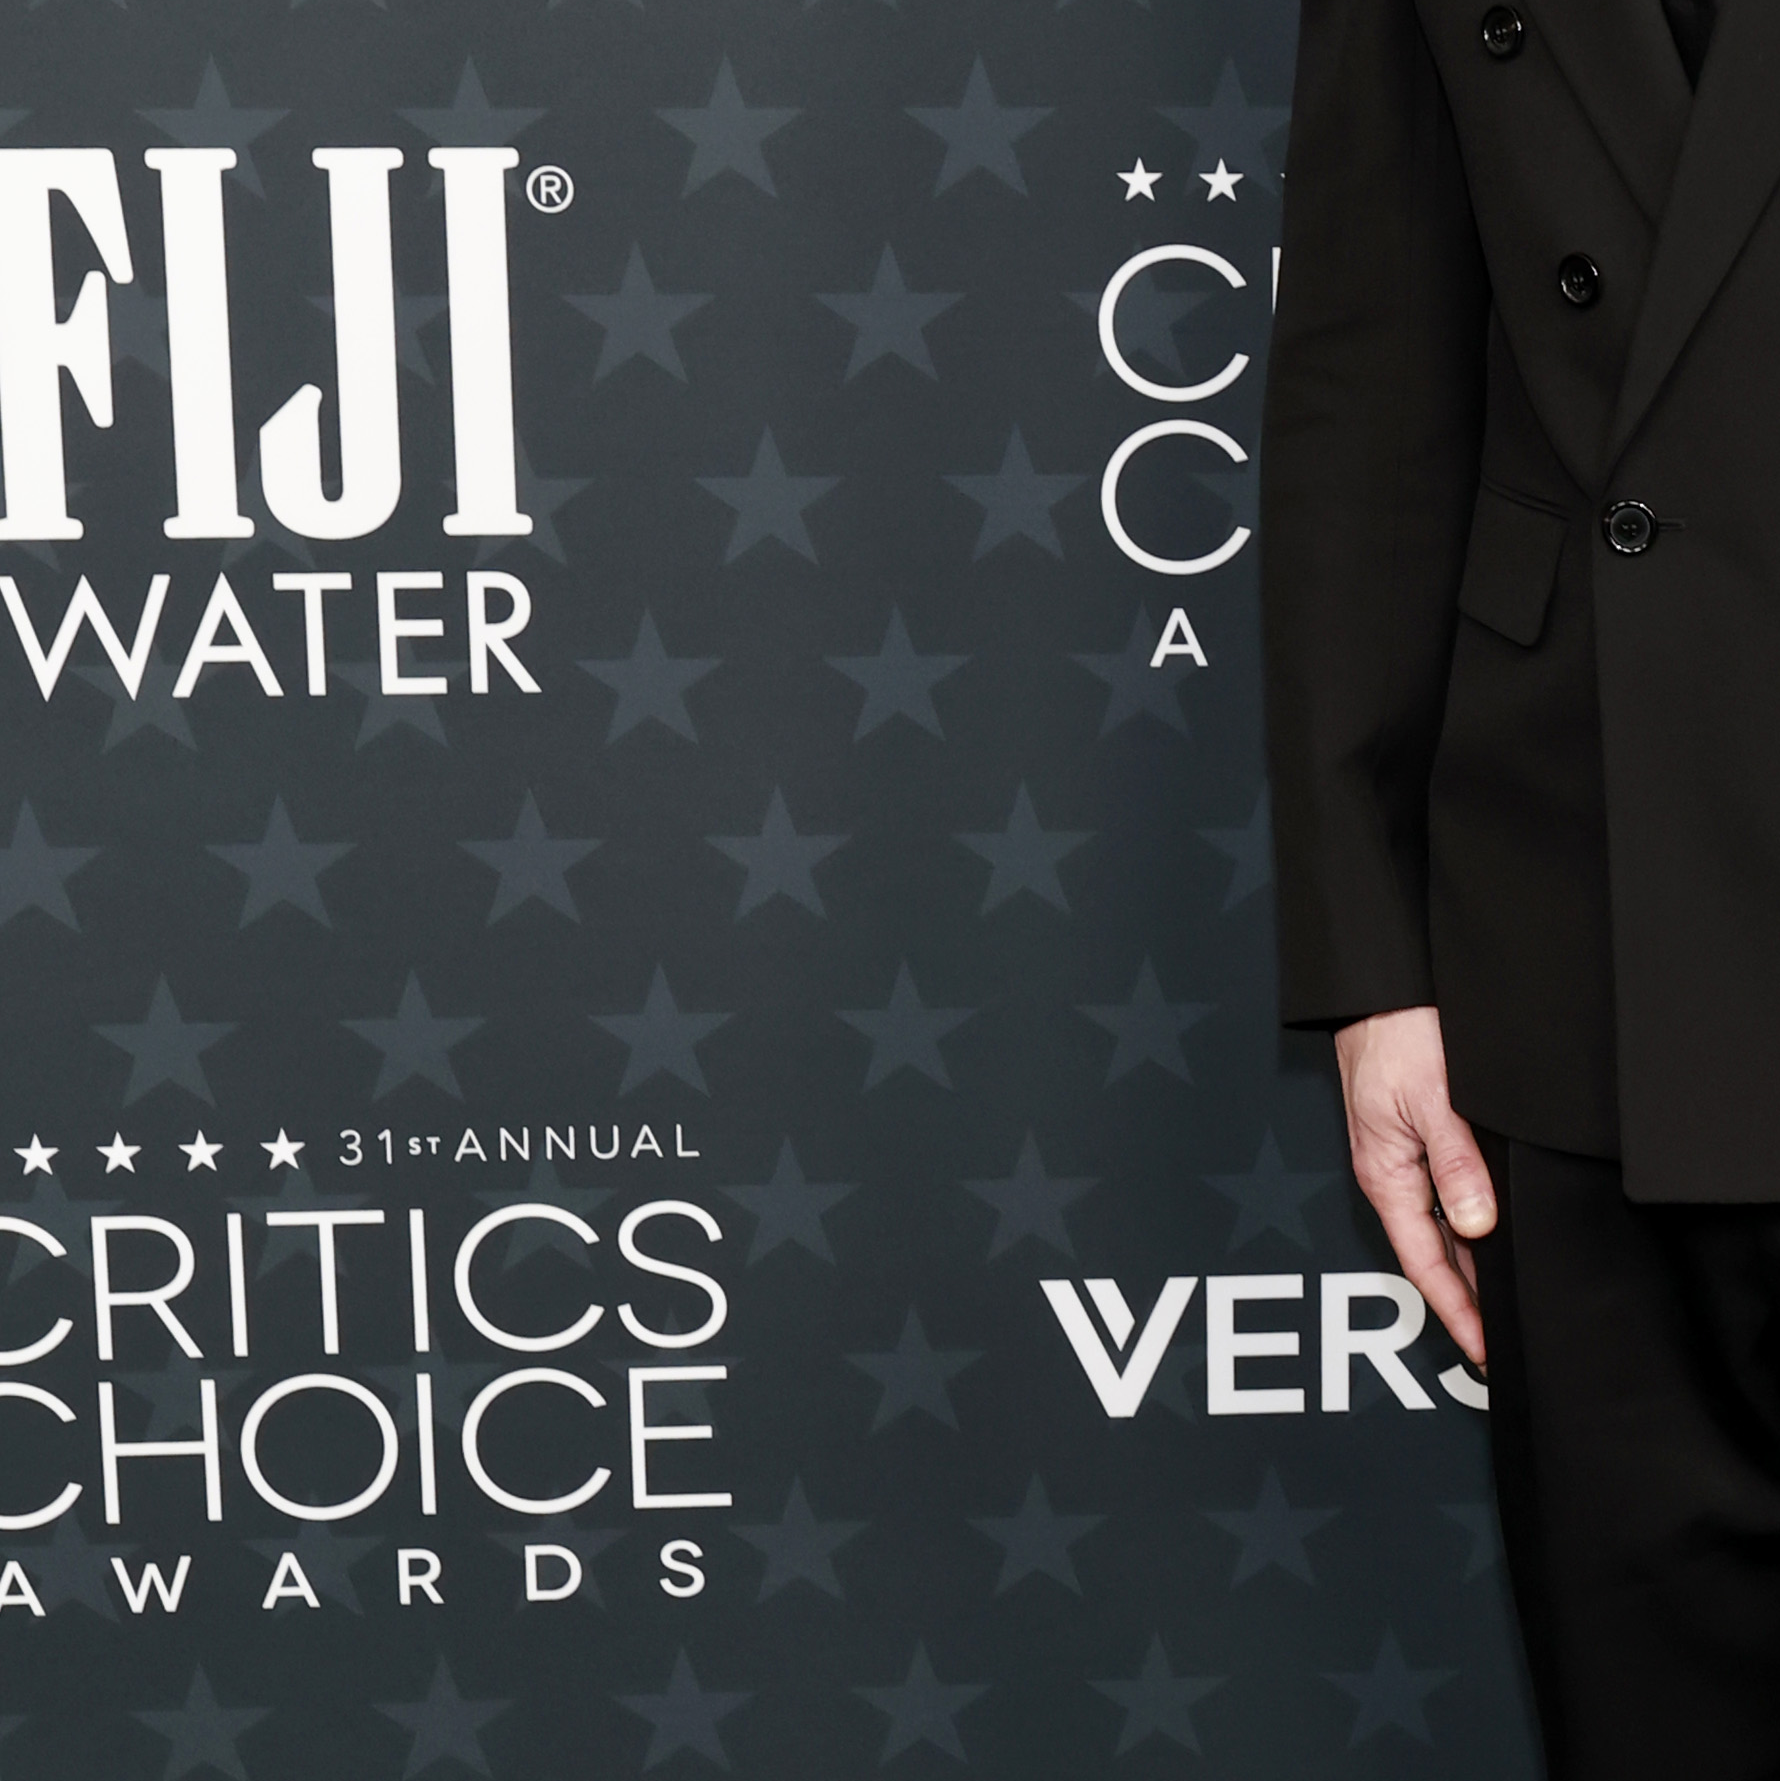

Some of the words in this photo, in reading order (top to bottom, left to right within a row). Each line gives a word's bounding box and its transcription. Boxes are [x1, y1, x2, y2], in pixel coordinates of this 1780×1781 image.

[0, 571, 542, 702] WATER
[454, 1123, 700, 1162] ANNUAL
[0, 1539, 705, 1617] AWARDS
